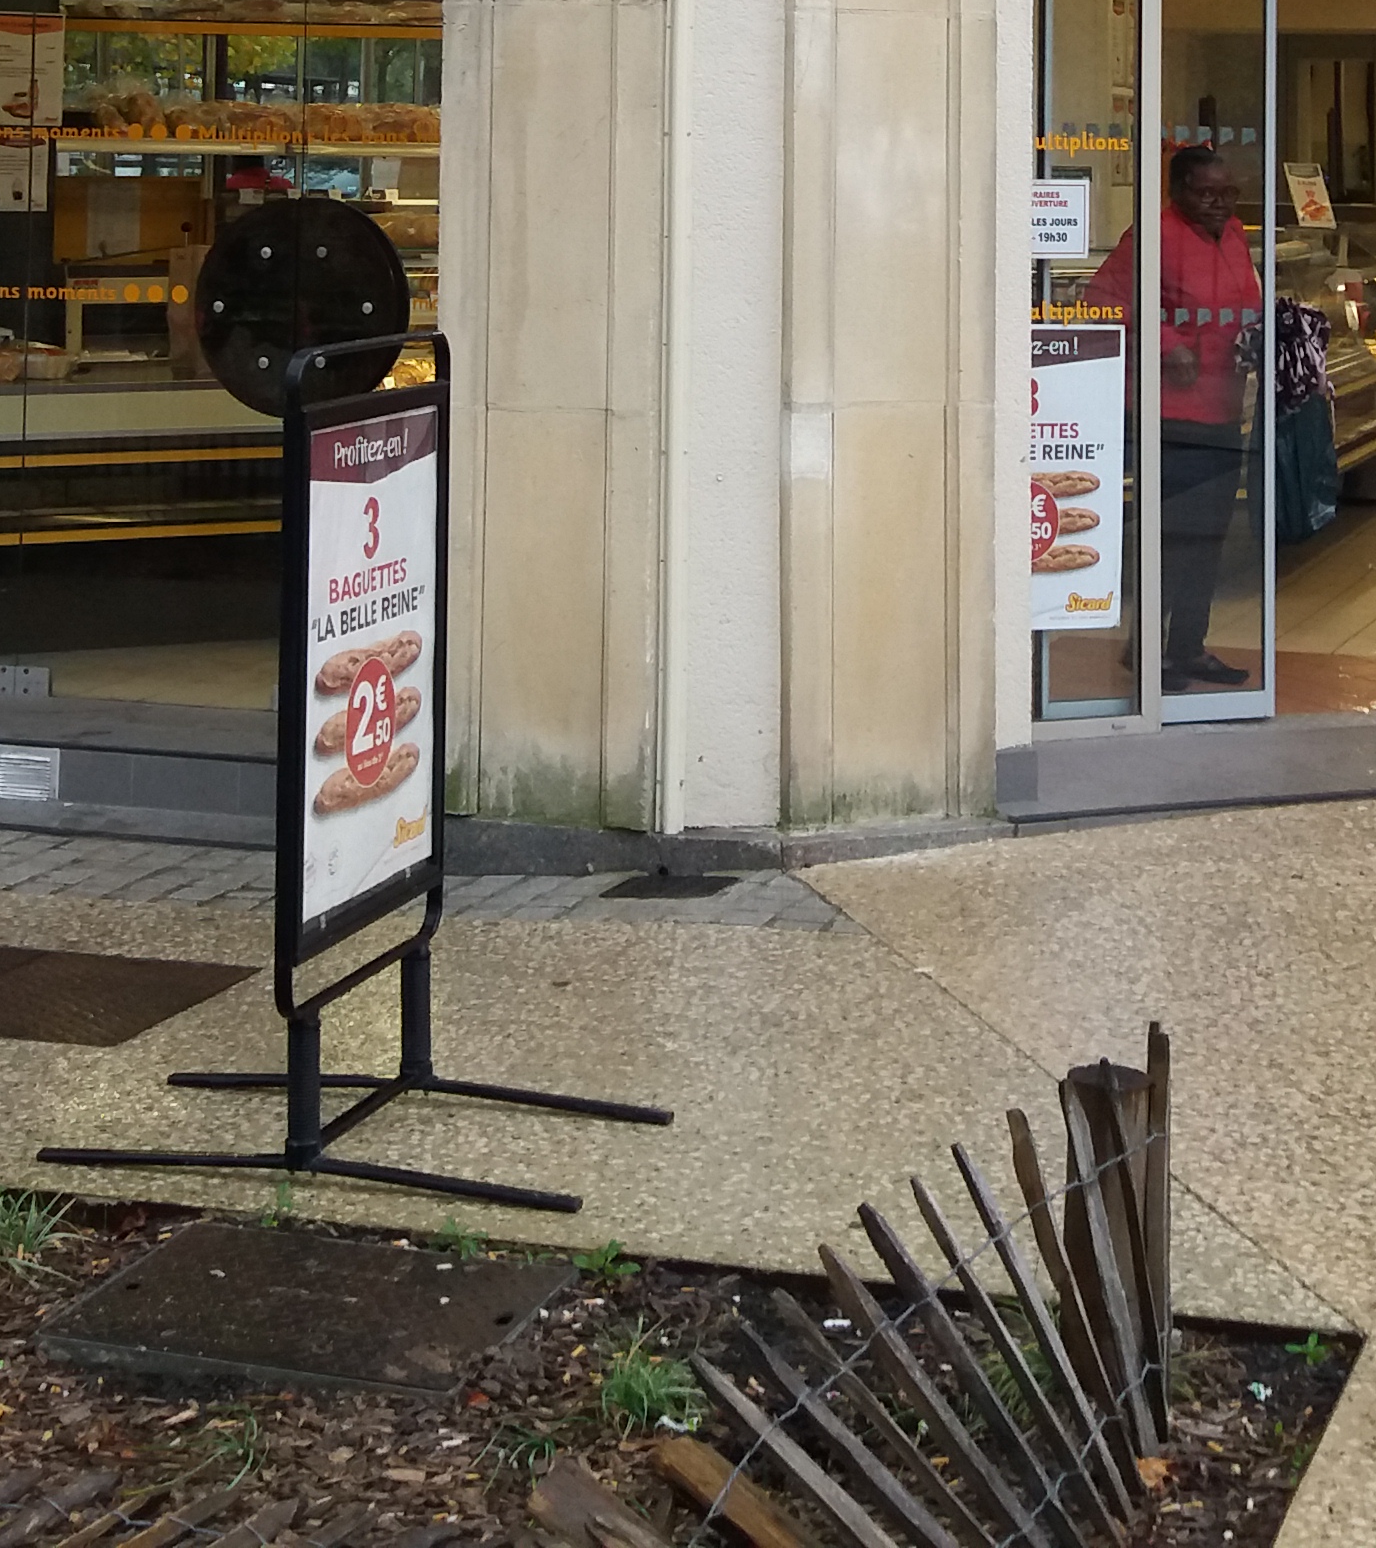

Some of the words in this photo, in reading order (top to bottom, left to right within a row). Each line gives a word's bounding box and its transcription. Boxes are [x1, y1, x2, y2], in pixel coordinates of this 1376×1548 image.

[32, 125, 120, 140] moments
[1035, 130, 1130, 158] ultiplions
[1031, 191, 1060, 199] RAIRES
[1031, 218, 1047, 226] LES
[1049, 218, 1078, 226] JOURS
[1038, 232, 1068, 243] 19h30
[27, 281, 116, 301] moments
[363, 496, 380, 560] 3
[329, 557, 407, 605] BAGUETTES
[1065, 591, 1114, 613] Sicard
[340, 600, 377, 636] BELLE
